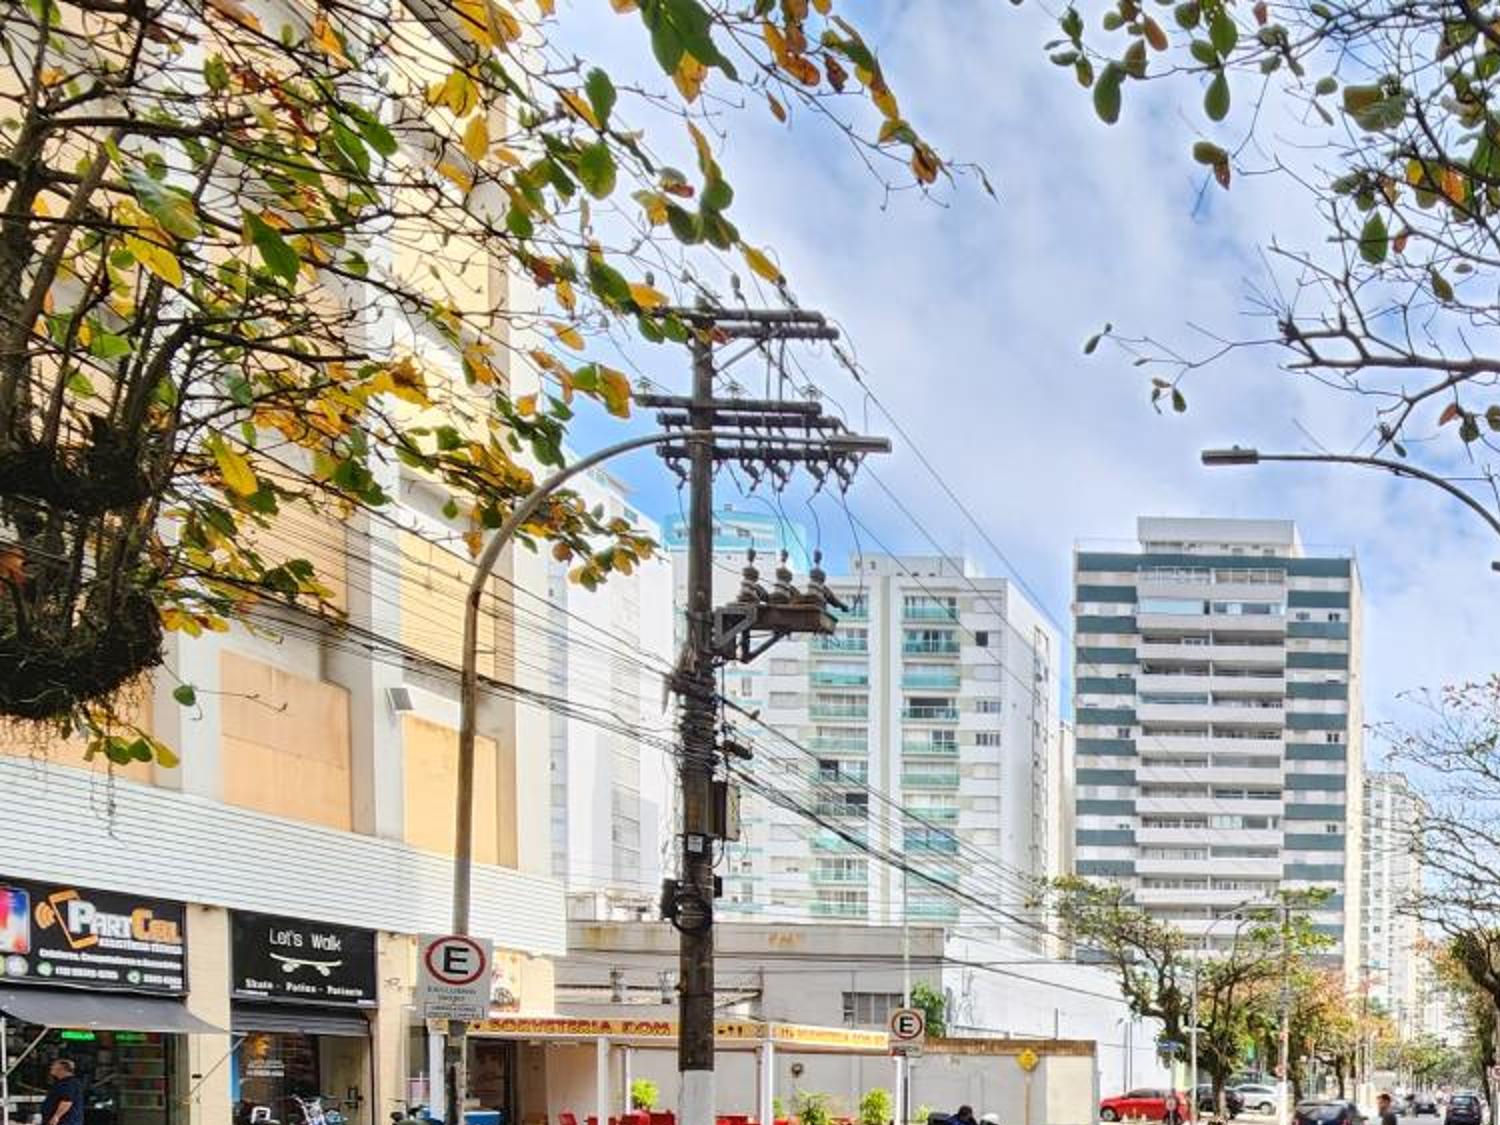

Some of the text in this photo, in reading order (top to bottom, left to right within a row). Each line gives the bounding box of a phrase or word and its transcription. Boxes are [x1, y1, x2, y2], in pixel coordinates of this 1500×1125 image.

[269, 928, 342, 951] Let's Walk
[443, 946, 469, 975] E
[900, 1016, 913, 1034] E
